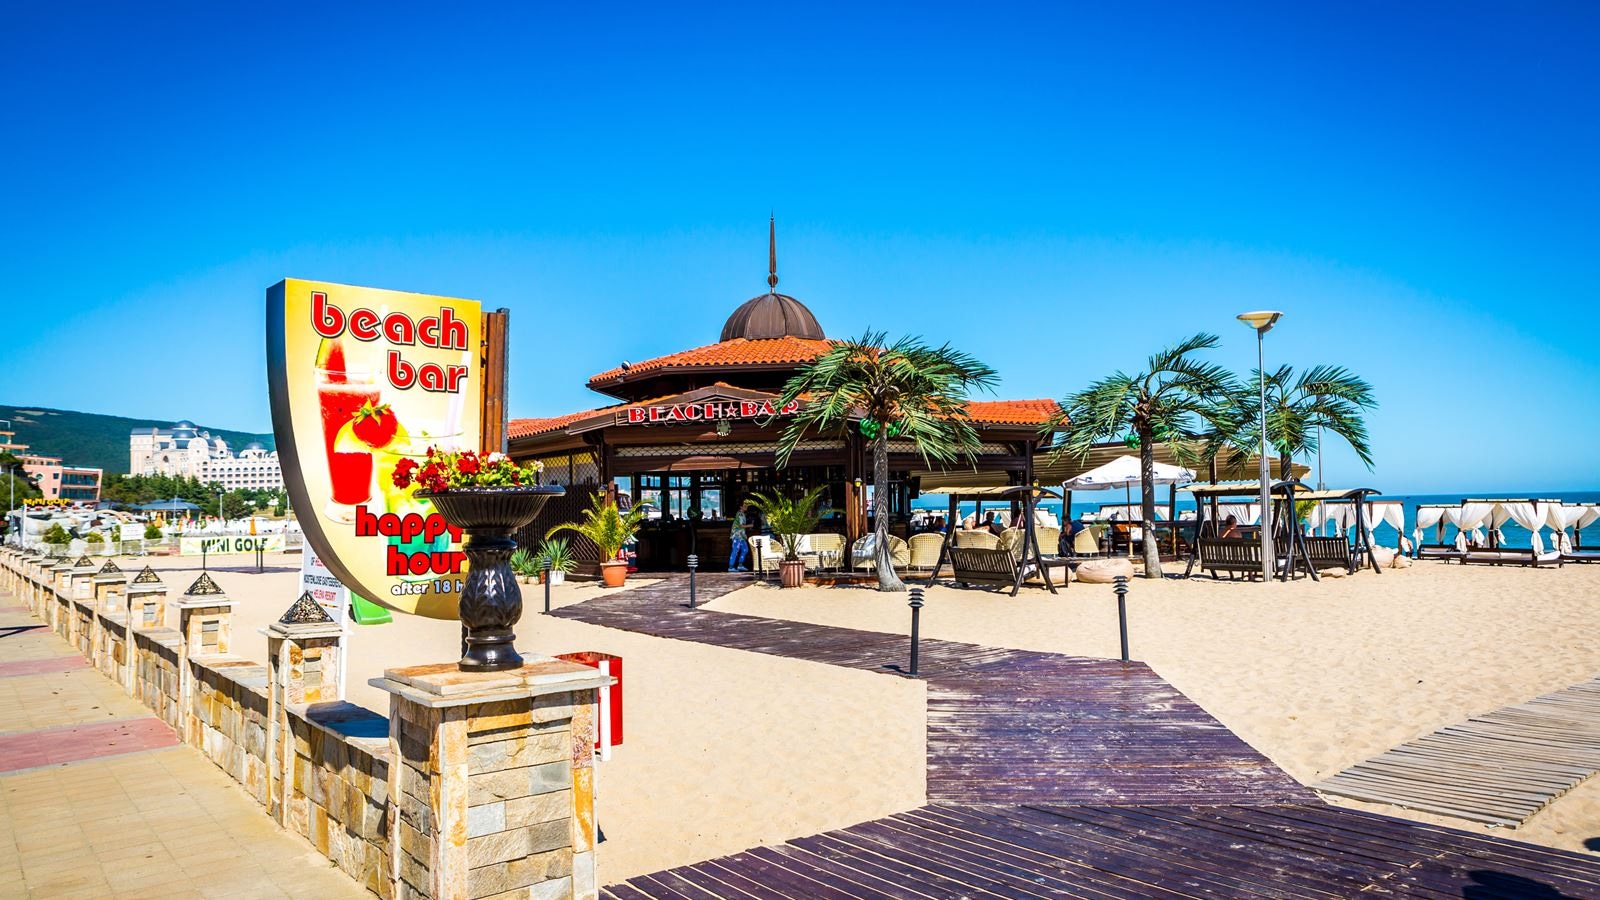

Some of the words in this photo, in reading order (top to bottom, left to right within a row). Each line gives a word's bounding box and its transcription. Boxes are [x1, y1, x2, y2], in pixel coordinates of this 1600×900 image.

[311, 292, 468, 350] beach
[387, 350, 468, 393] bar
[628, 403, 722, 422] BEACH
[741, 399, 799, 416] BAR
[201, 538, 230, 553] MINI
[235, 537, 268, 552] GOLF
[387, 545, 467, 576] hour
[391, 582, 429, 595] after
[434, 580, 451, 594] 18
